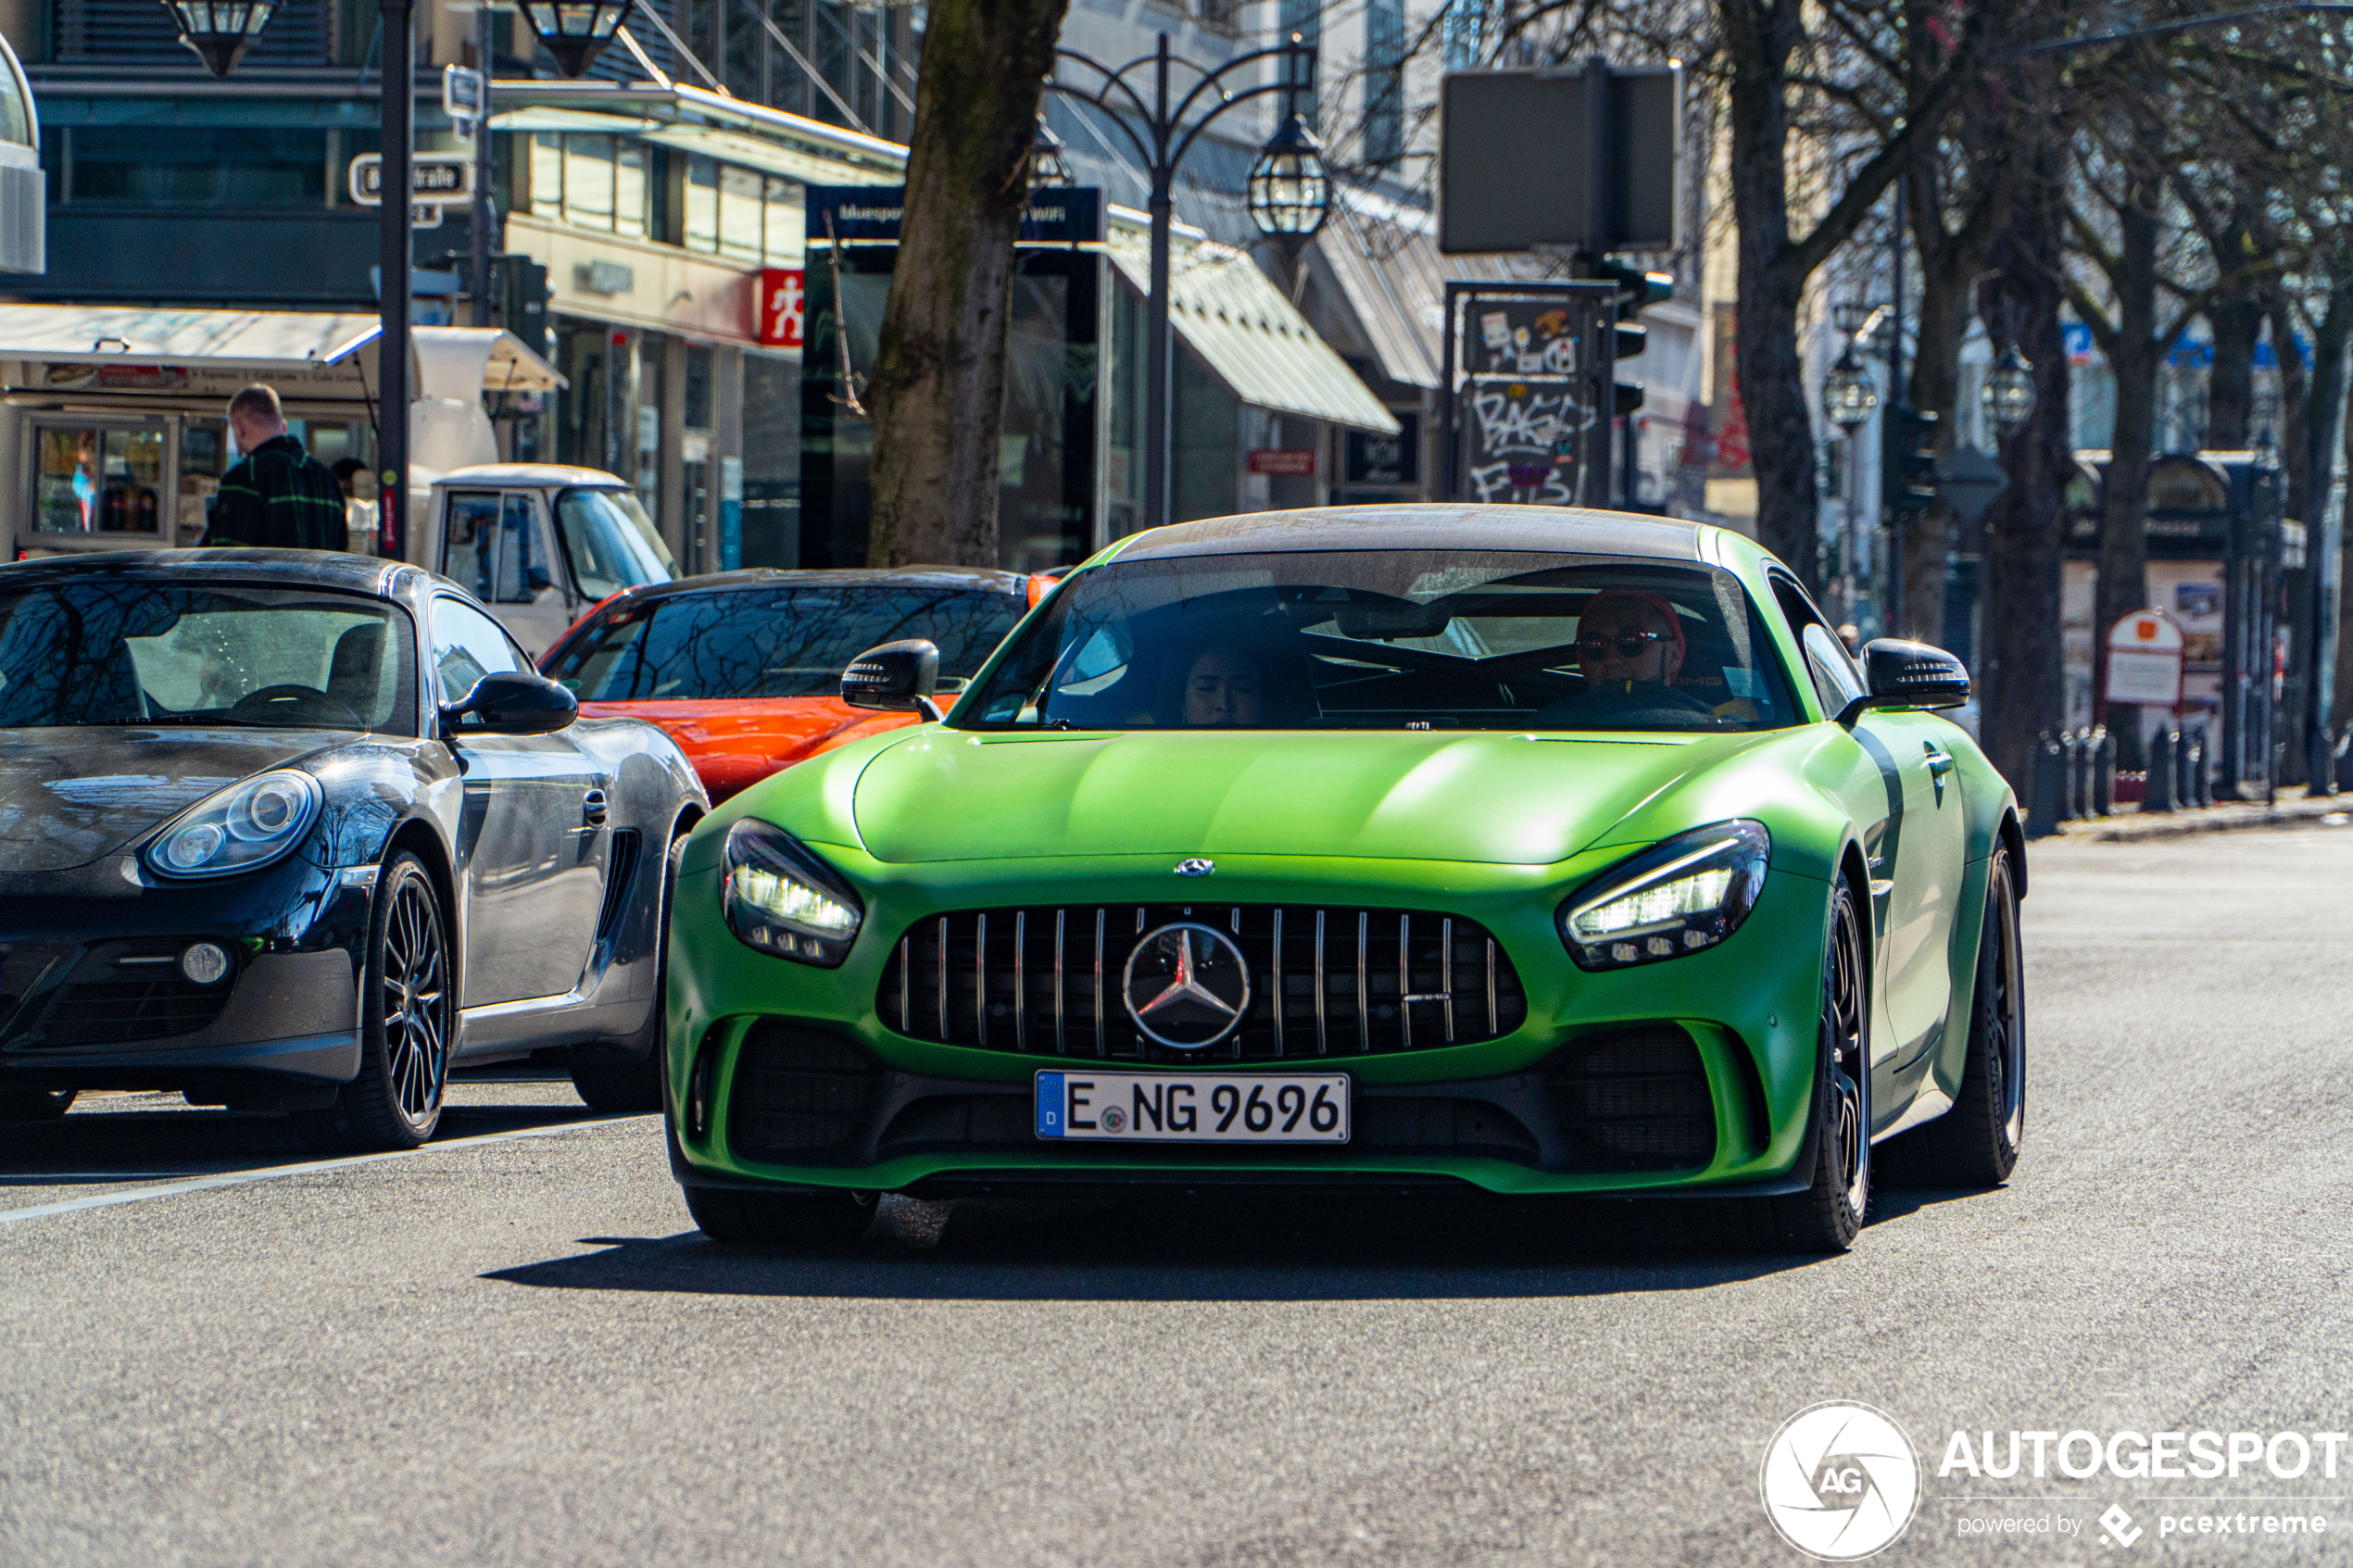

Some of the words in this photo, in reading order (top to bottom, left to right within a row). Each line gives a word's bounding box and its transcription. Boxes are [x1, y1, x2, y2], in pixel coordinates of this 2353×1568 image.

[839, 204, 904, 224] bluespo
[1045, 1110, 1057, 1125] D
[1068, 1082, 1097, 1130] E
[1133, 1084, 1198, 1133] NG
[1211, 1084, 1340, 1133] 9696
